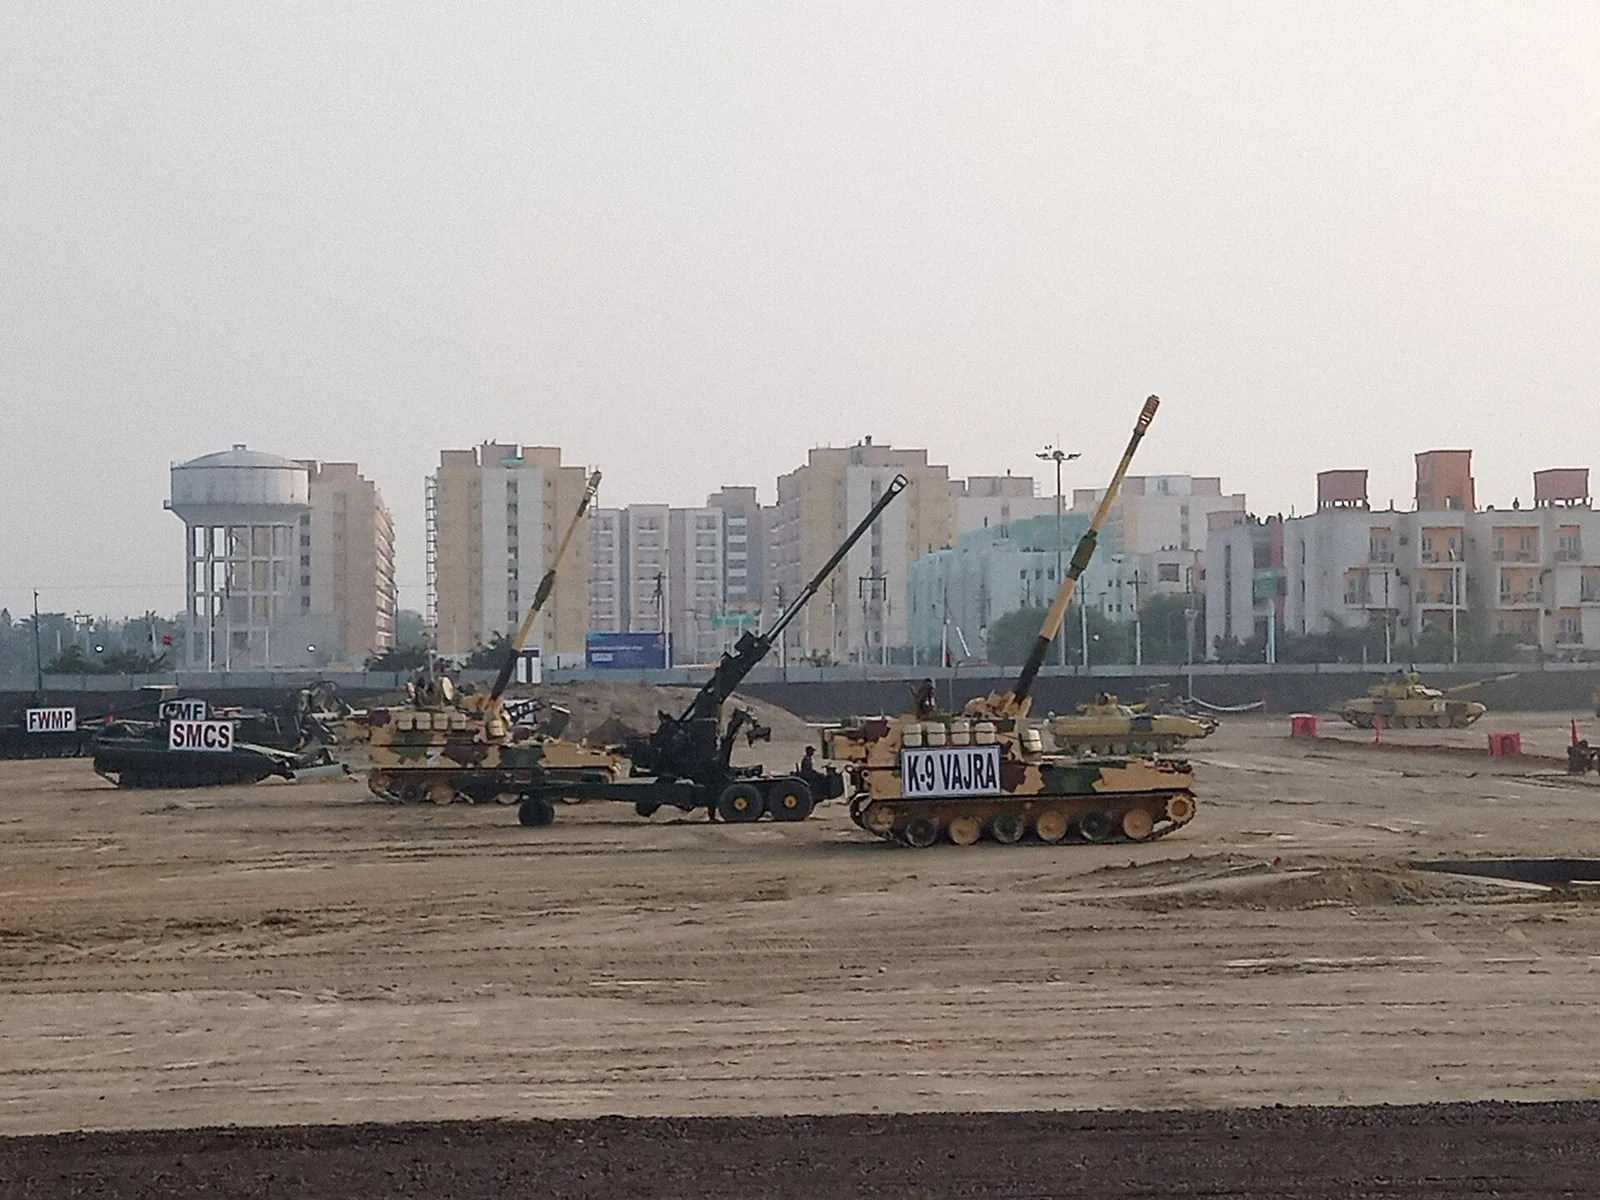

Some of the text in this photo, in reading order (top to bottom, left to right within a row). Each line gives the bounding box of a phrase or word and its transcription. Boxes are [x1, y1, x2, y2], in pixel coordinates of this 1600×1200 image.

[29, 711, 72, 730] FWMP
[172, 723, 229, 748] SMCS
[908, 752, 997, 792] K-9 VAJRA
